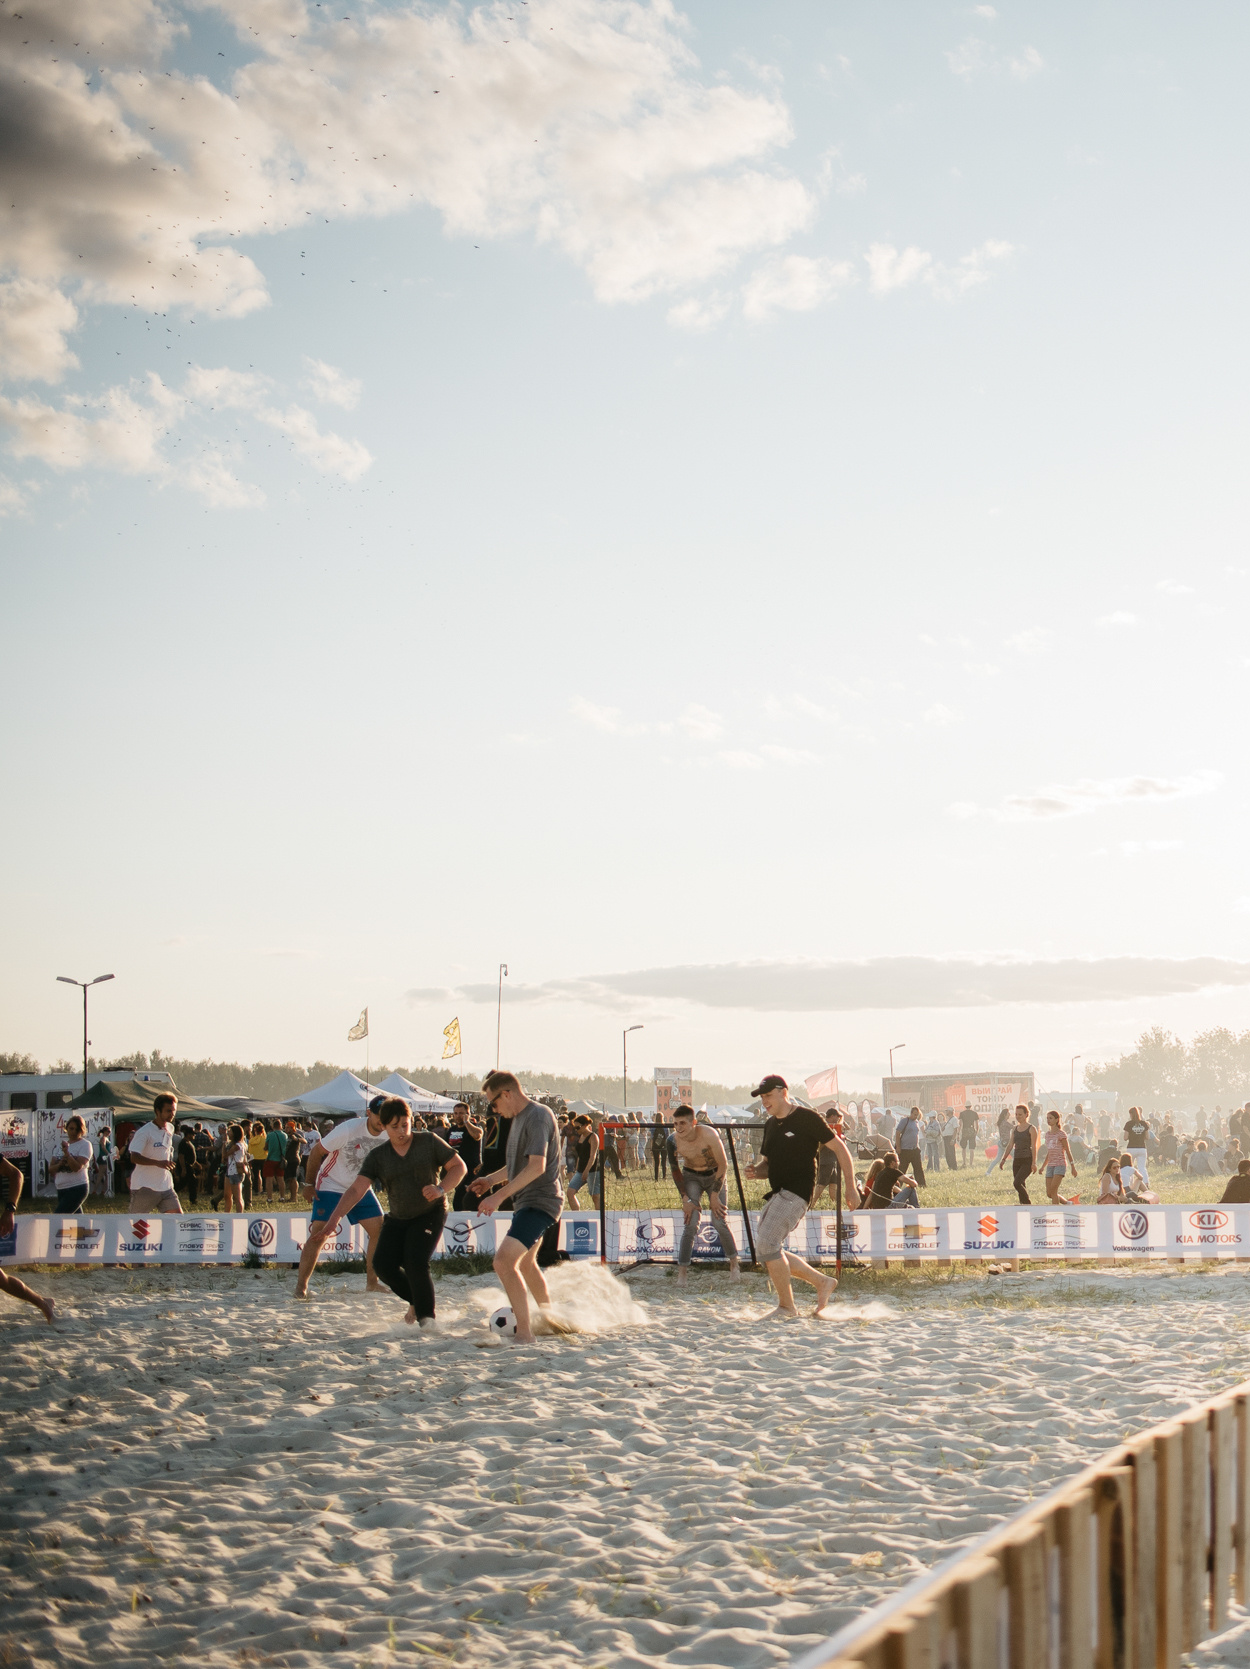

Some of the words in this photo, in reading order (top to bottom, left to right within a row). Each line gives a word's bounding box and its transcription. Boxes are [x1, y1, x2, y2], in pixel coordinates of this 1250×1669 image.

[1196, 1214, 1222, 1225] KIA
[1175, 1235, 1193, 1243] KIA
[1197, 1234, 1242, 1243] MOTORS
[119, 1243, 163, 1251] SUZUKI
[321, 1242, 354, 1251] OTORS
[446, 1244, 476, 1255] УАЗ
[888, 1241, 941, 1249] CHEVROLET
[963, 1241, 1014, 1250] SUZUKI
[1112, 1245, 1155, 1253] Volkswagen
